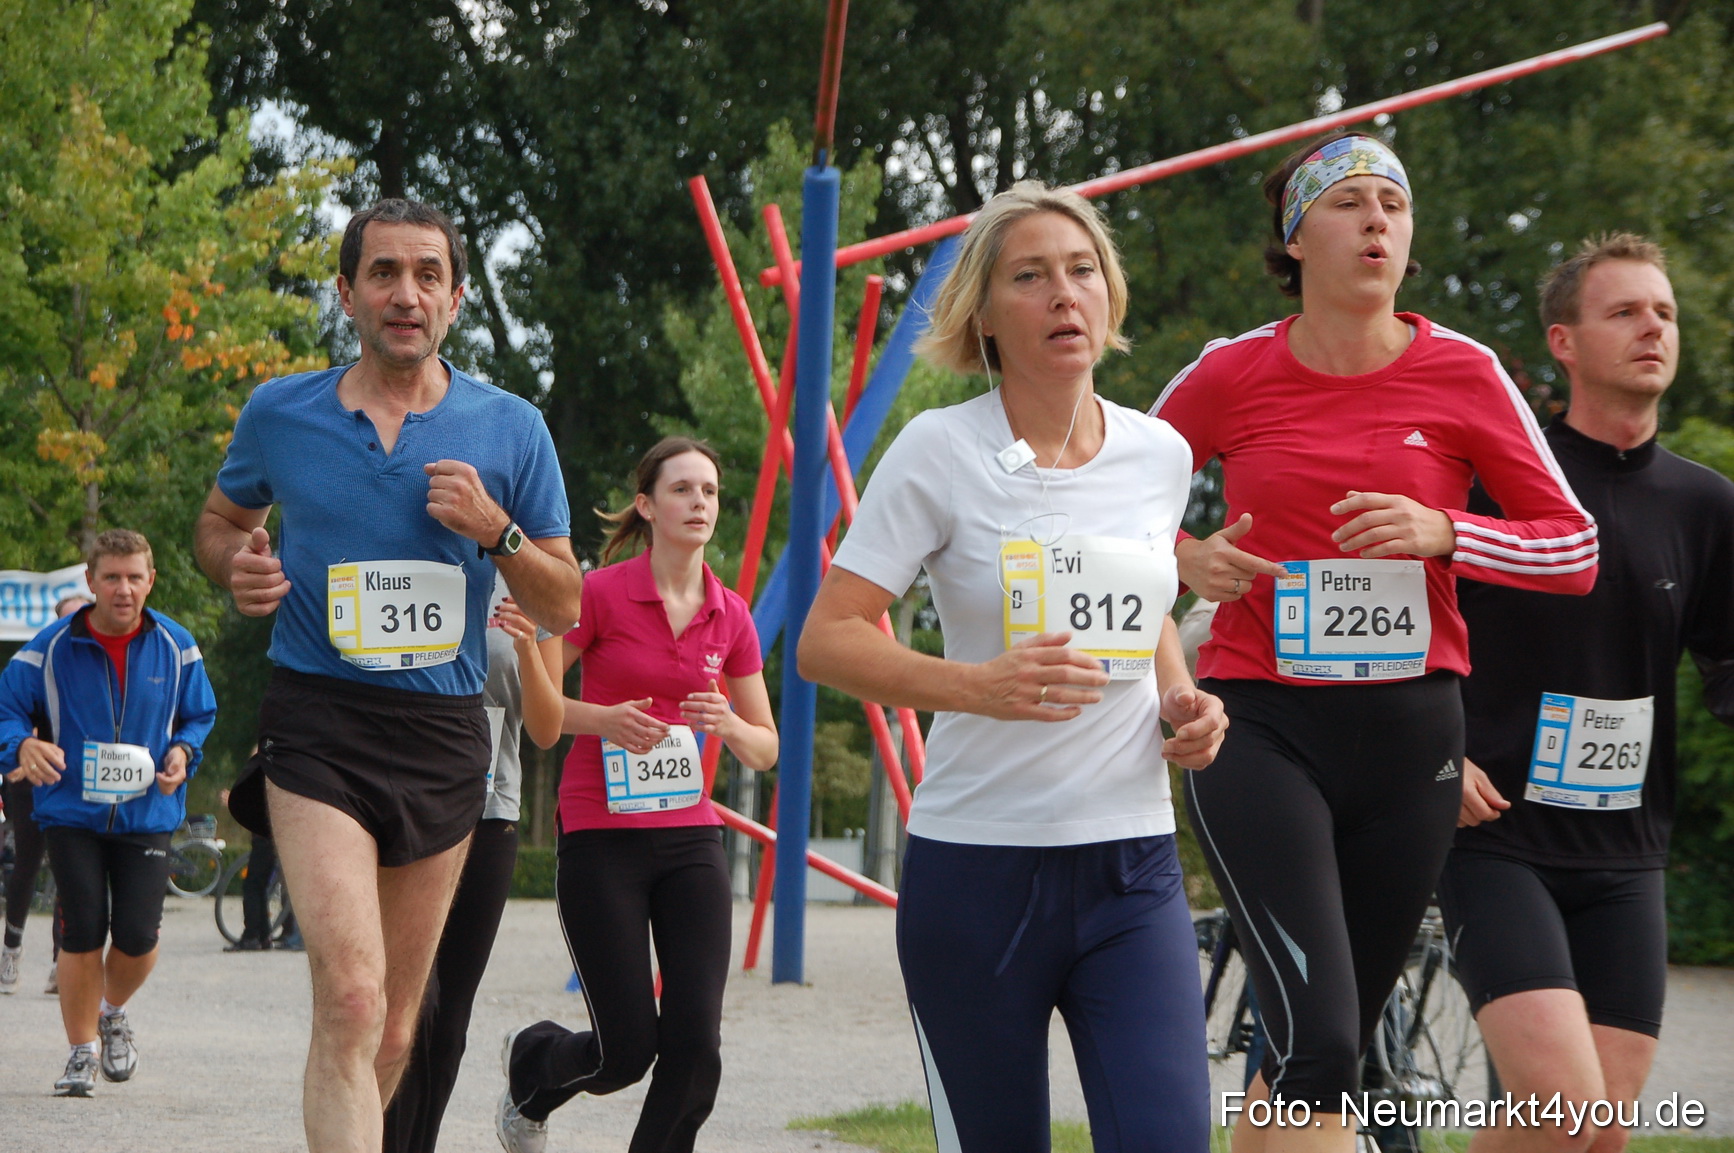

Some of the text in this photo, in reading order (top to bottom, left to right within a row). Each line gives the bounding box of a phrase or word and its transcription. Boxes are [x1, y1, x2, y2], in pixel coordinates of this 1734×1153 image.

[1052, 548, 1081, 574] Evi
[365, 571, 411, 591] Klaus
[1321, 570, 1372, 592] Petra
[1012, 590, 1022, 609] D
[335, 605, 343, 620] D
[380, 602, 442, 634] 316
[1070, 593, 1143, 632] 812
[1288, 605, 1297, 620] D
[1323, 605, 1416, 637] 2264
[1582, 708, 1626, 730] Peter
[1547, 735, 1557, 750] D
[101, 749, 131, 761] Robert
[1577, 741, 1642, 770] 2263
[101, 766, 143, 782] 2301
[636, 757, 692, 782] 3428
